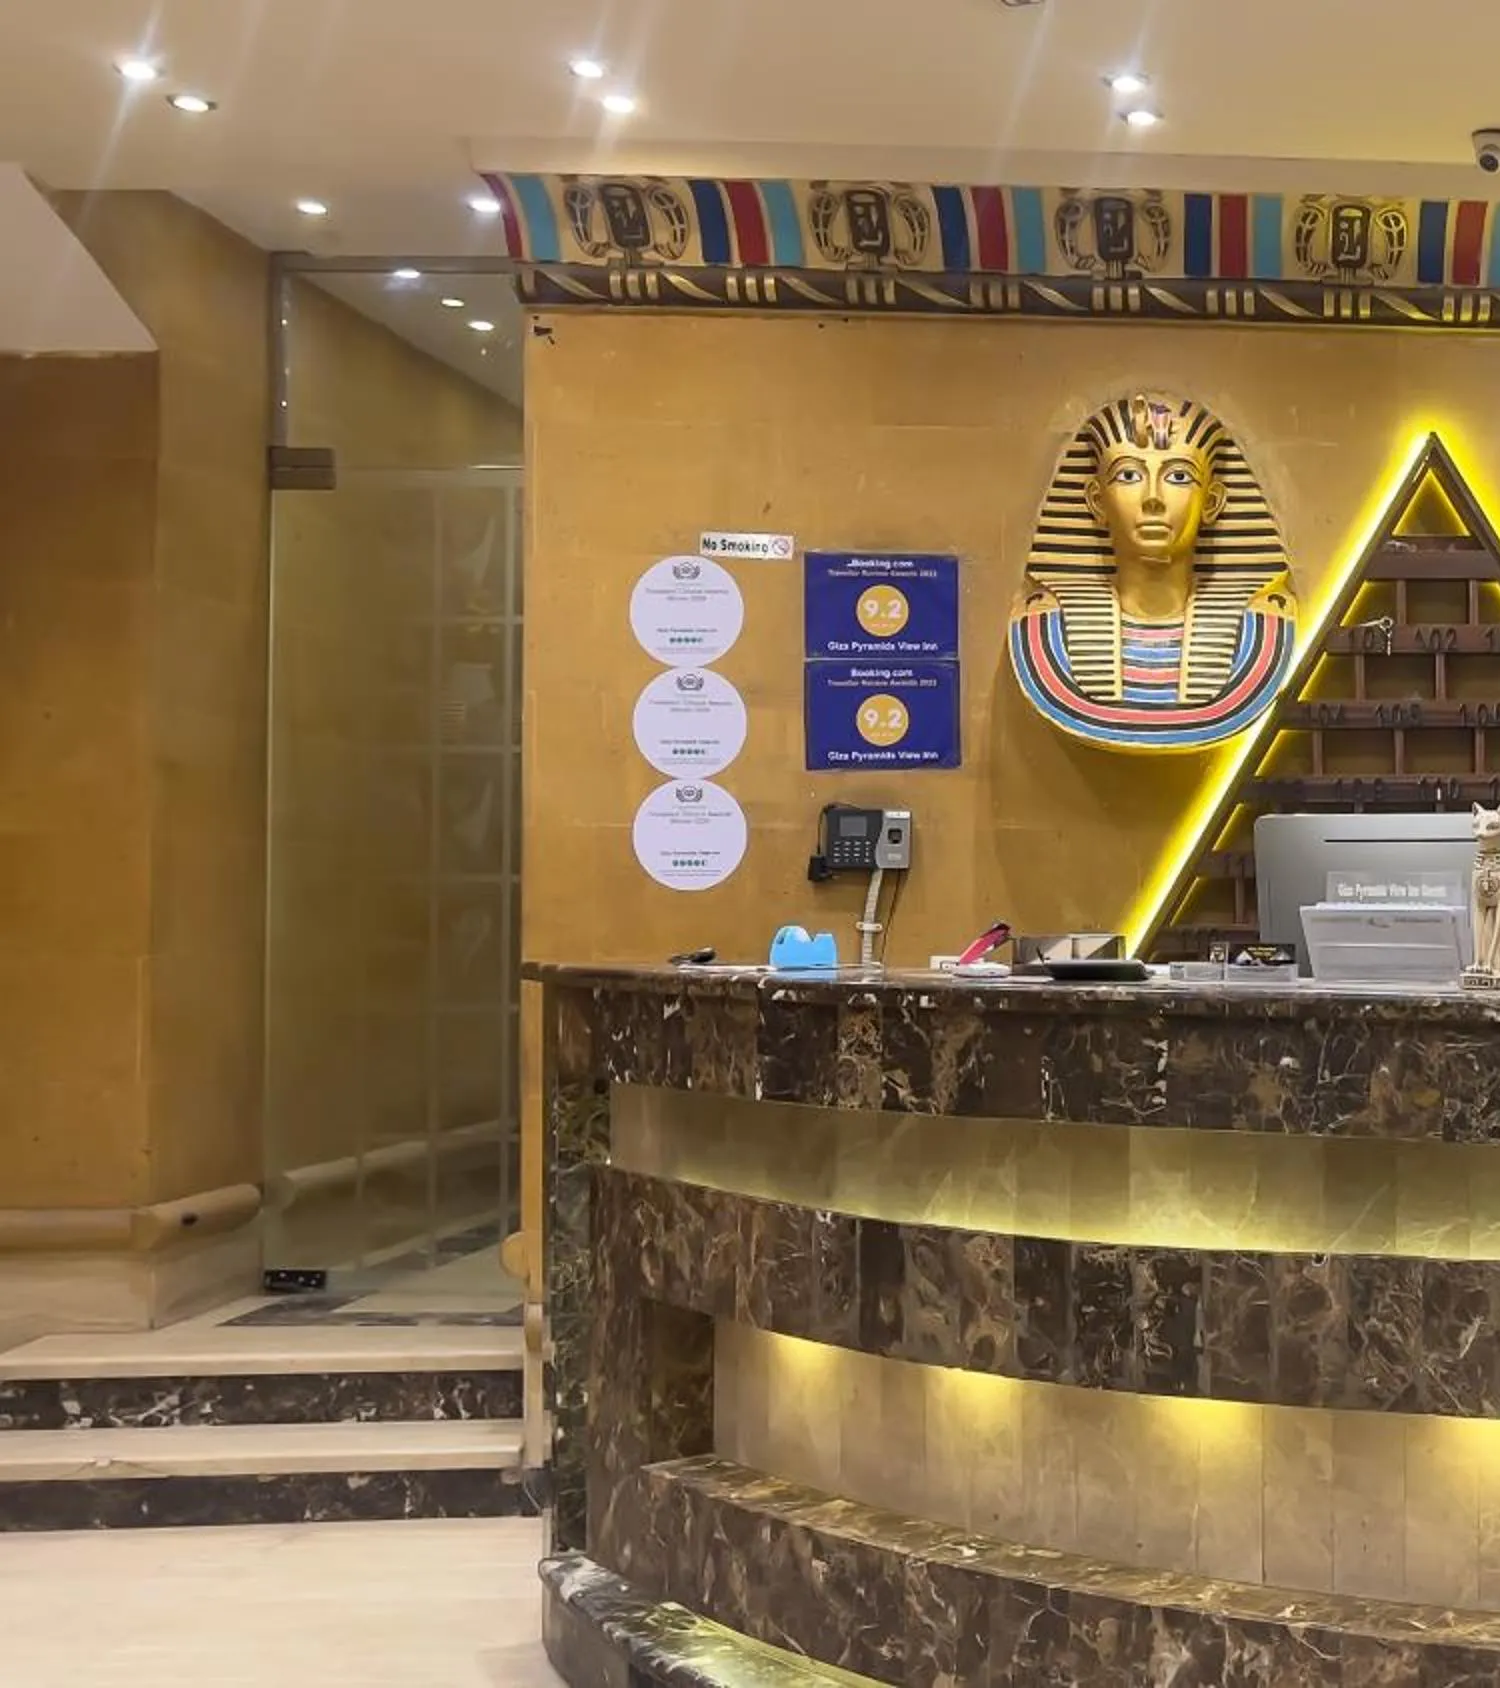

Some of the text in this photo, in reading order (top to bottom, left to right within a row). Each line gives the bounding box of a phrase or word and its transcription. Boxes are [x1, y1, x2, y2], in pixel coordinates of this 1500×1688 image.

[703, 537, 717, 551] No
[850, 558, 914, 570] Booking.com
[863, 599, 902, 620] 9.2
[1414, 627, 1458, 651] 102
[827, 641, 938, 653] Giza Pyramids View Inn
[850, 668, 914, 679] Booking.com
[863, 708, 902, 729] 9.2
[827, 751, 939, 763] Giza Pyramids View Inn
